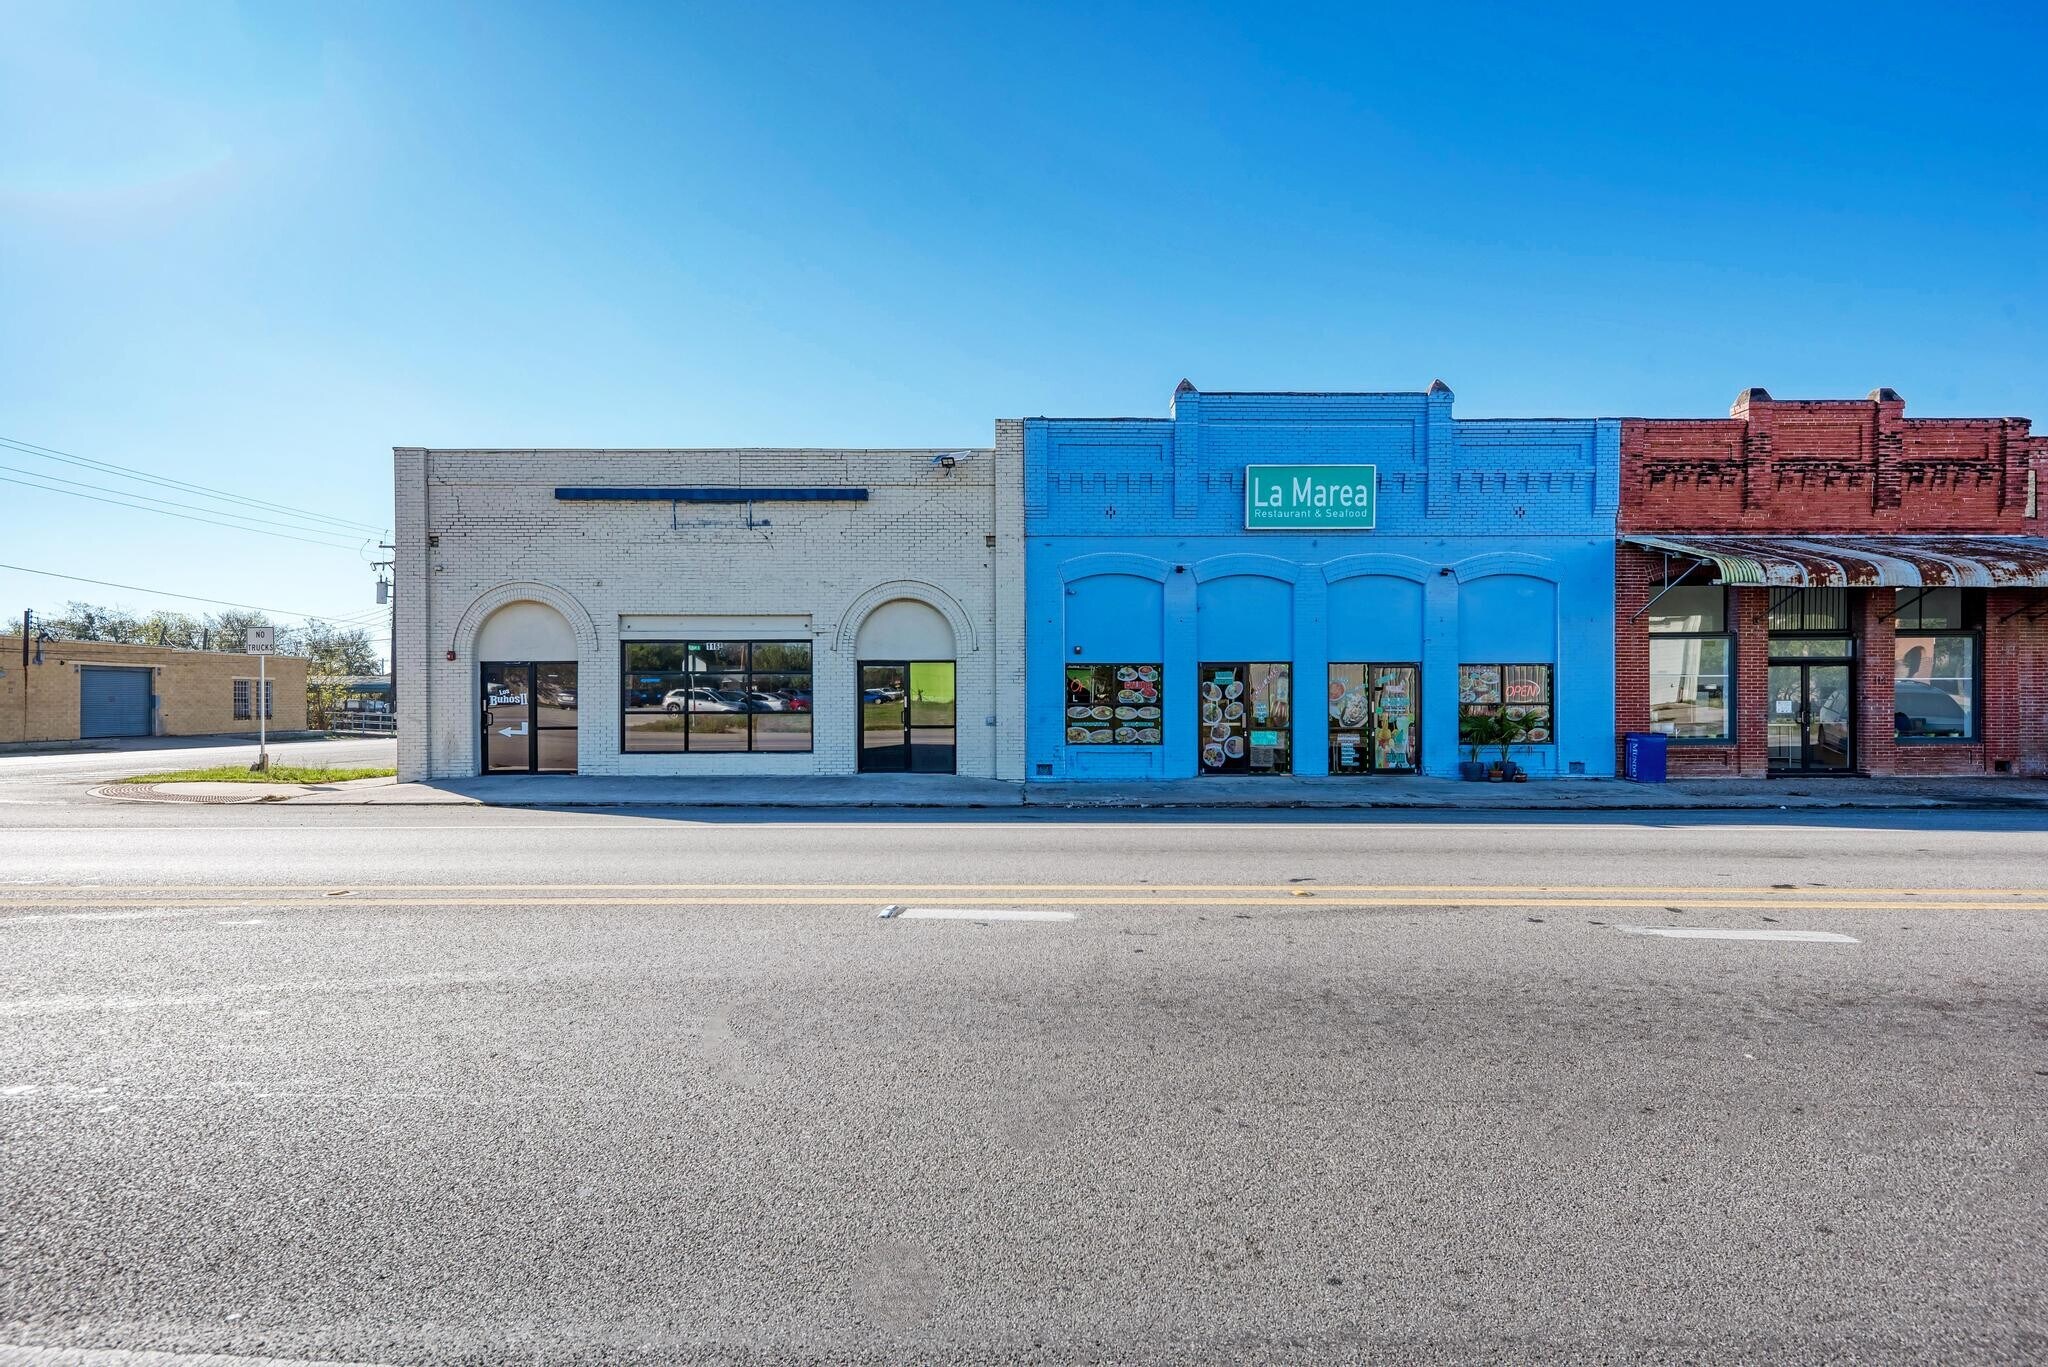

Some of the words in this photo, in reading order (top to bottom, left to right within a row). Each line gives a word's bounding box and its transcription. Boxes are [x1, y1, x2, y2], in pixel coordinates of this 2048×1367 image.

[1254, 477, 1282, 507] La
[1292, 477, 1368, 507] Marea
[1254, 509, 1311, 518] Restaurant
[1314, 509, 1322, 518] &
[1325, 509, 1368, 518] Seafood
[255, 631, 265, 639] NO
[248, 643, 273, 652] TRUCKS
[1505, 685, 1537, 697] OPEN
[489, 695, 520, 706] Buhos
